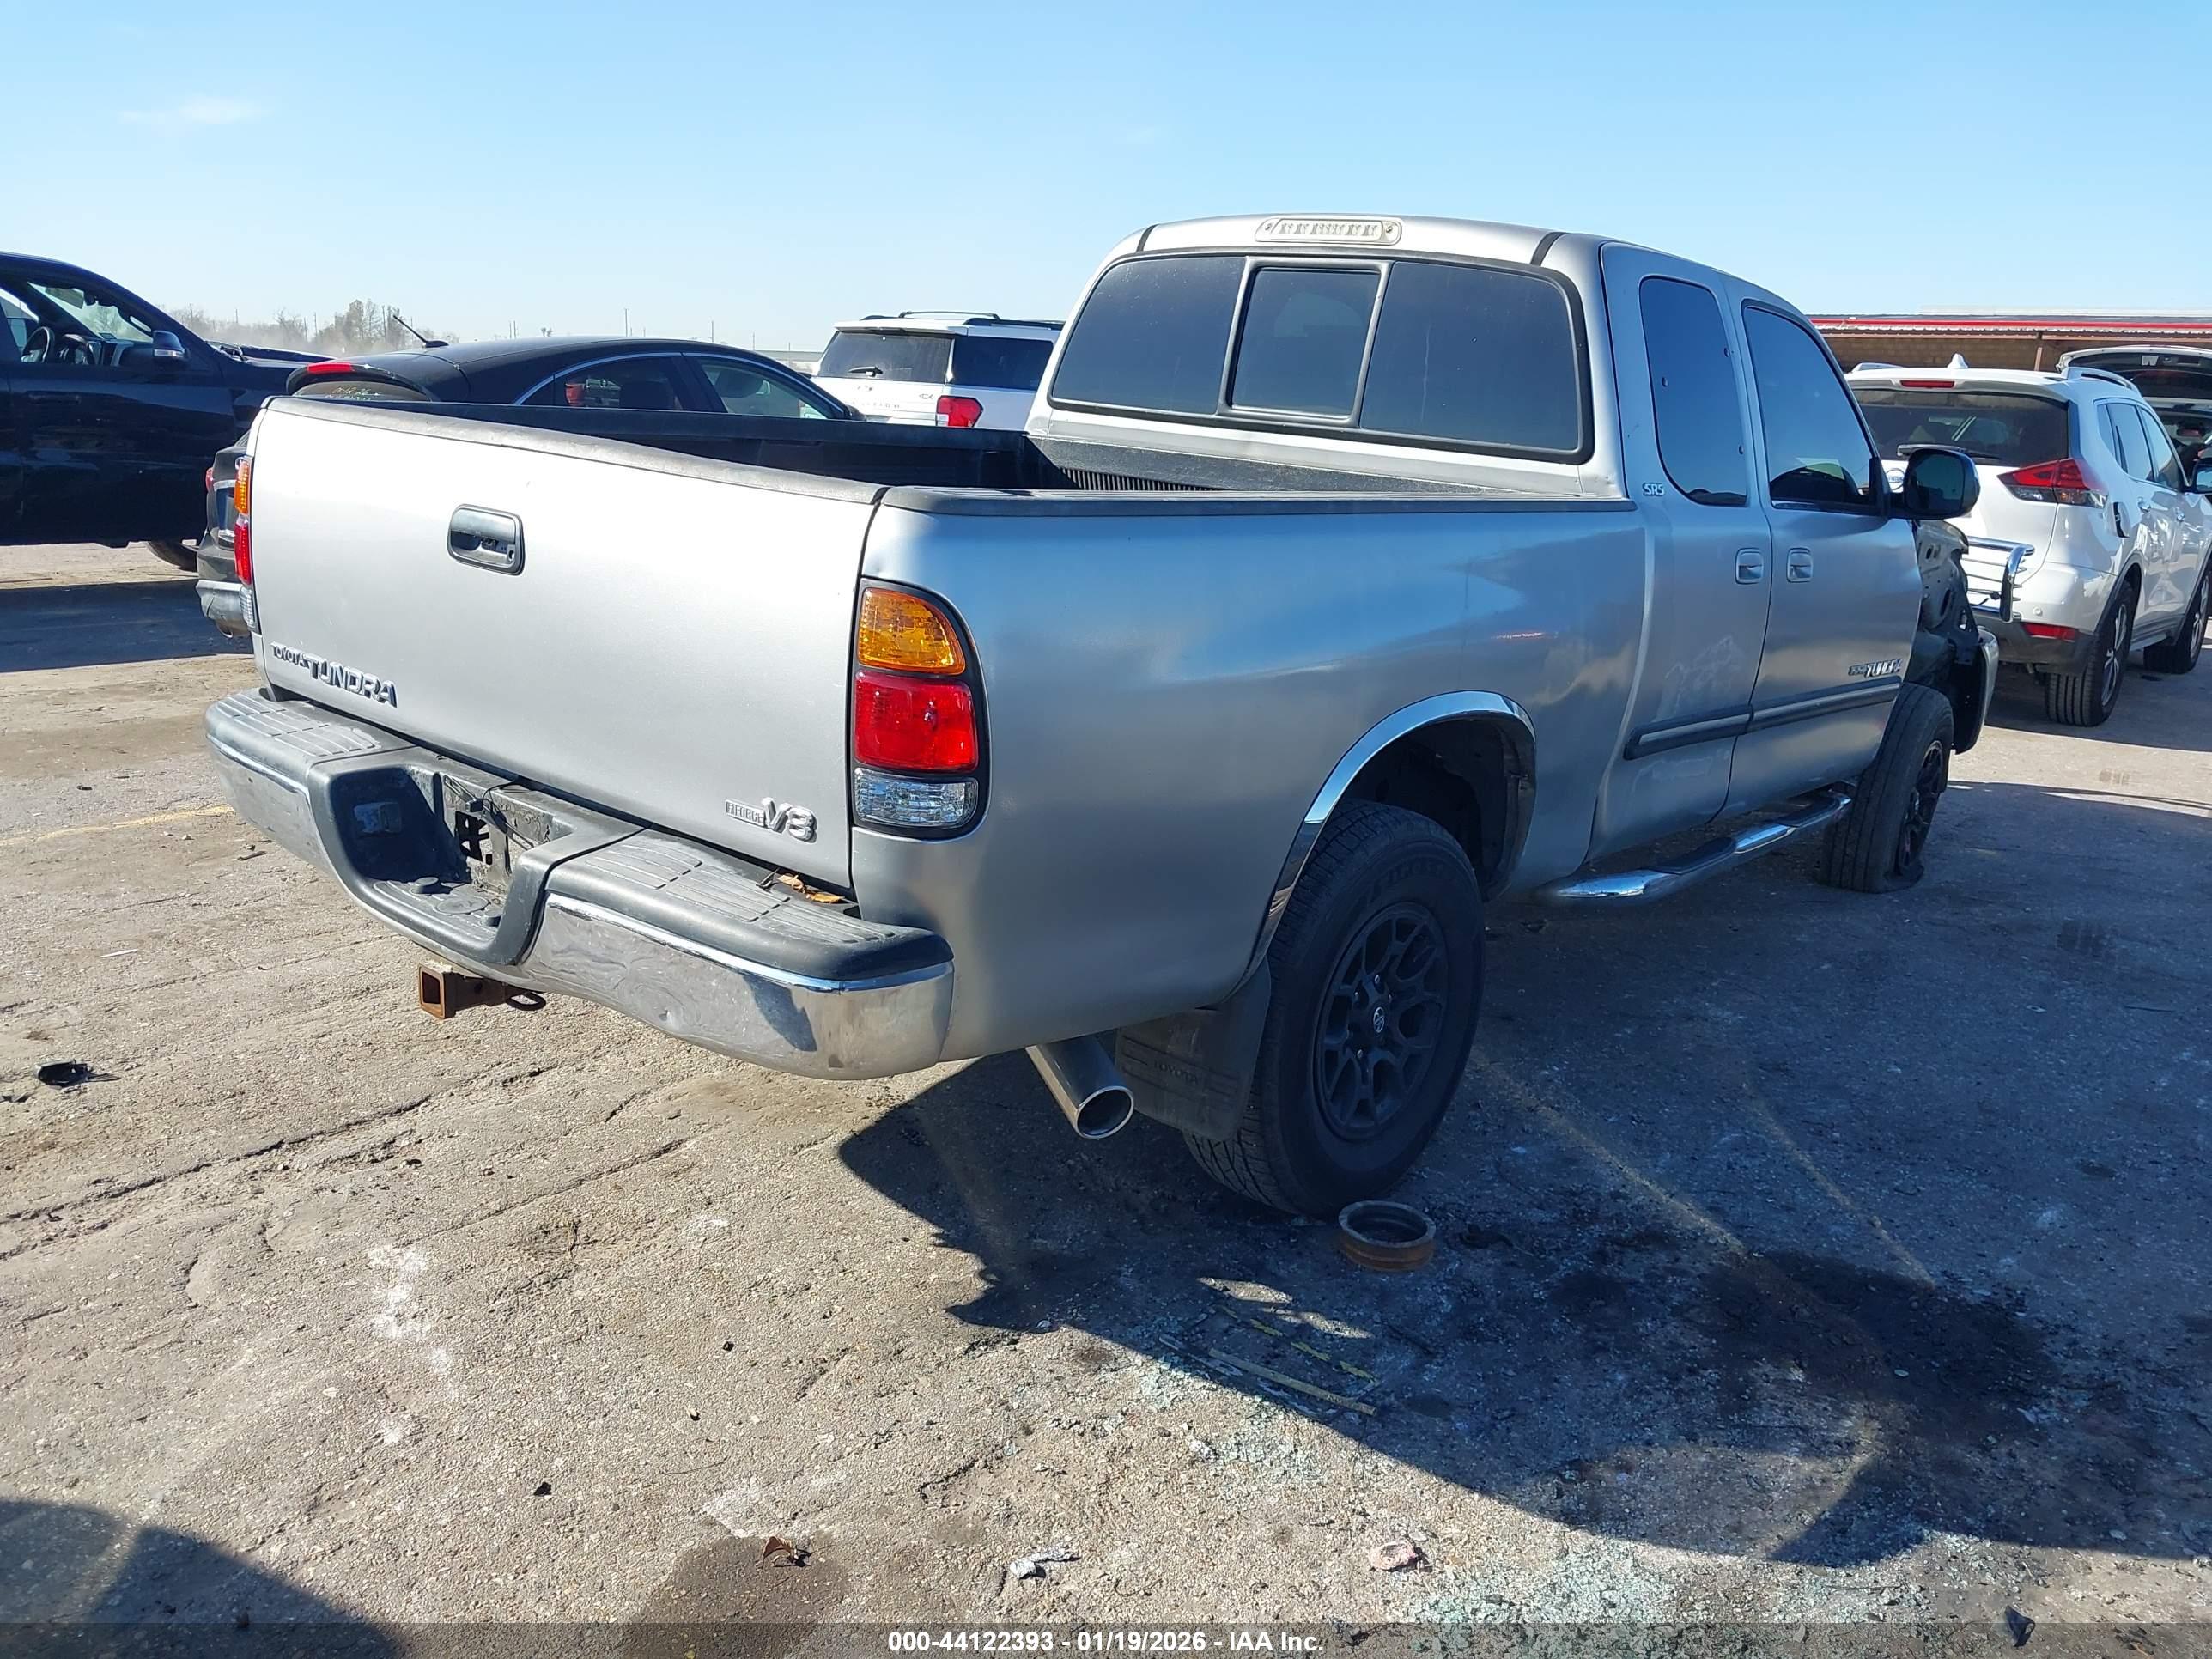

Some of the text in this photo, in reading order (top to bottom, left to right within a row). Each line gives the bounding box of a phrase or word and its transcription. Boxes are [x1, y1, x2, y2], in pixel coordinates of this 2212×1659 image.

[1642, 482, 1665, 497] SR5
[270, 641, 398, 708] TOYOTA TUNDRA
[761, 797, 817, 843] V8
[1153, 1058, 1199, 1086] TOYOTA
